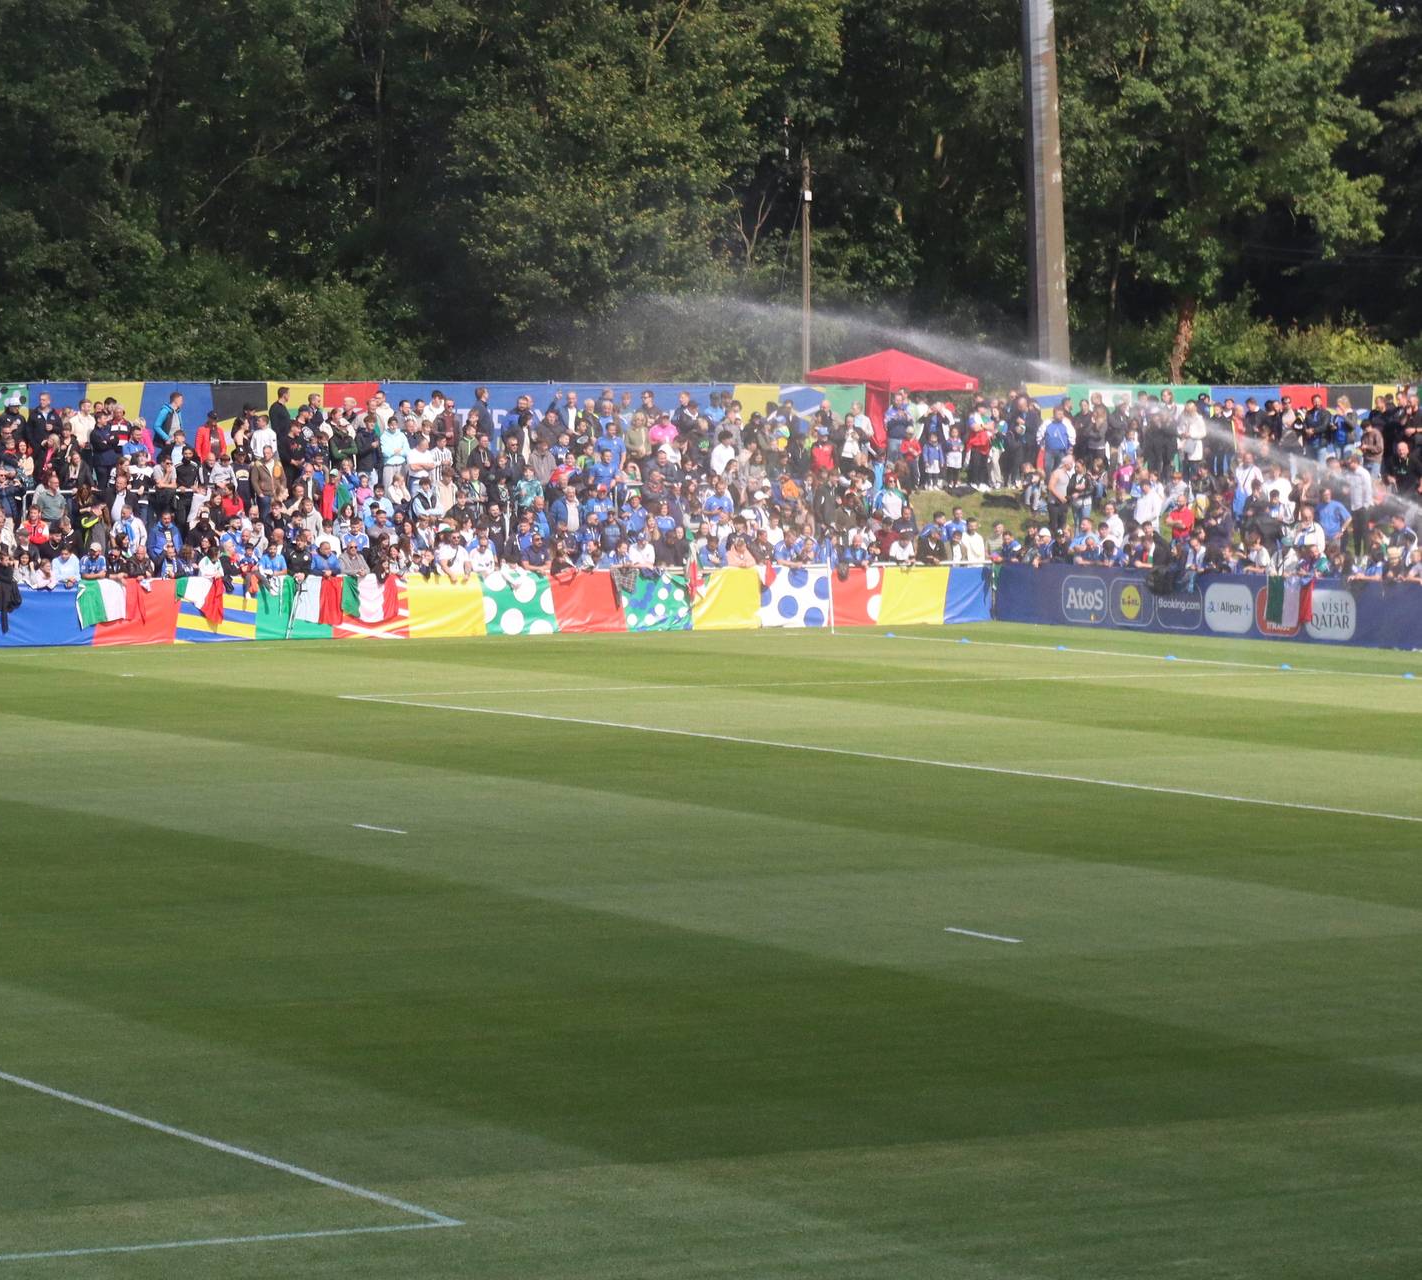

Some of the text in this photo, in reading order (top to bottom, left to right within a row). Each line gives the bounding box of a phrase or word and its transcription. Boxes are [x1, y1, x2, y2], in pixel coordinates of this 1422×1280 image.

[1066, 587, 1103, 611] Atos
[1158, 598, 1201, 612] Booking.com
[1220, 602, 1242, 615] Alipay
[1311, 612, 1350, 630] QATAR
